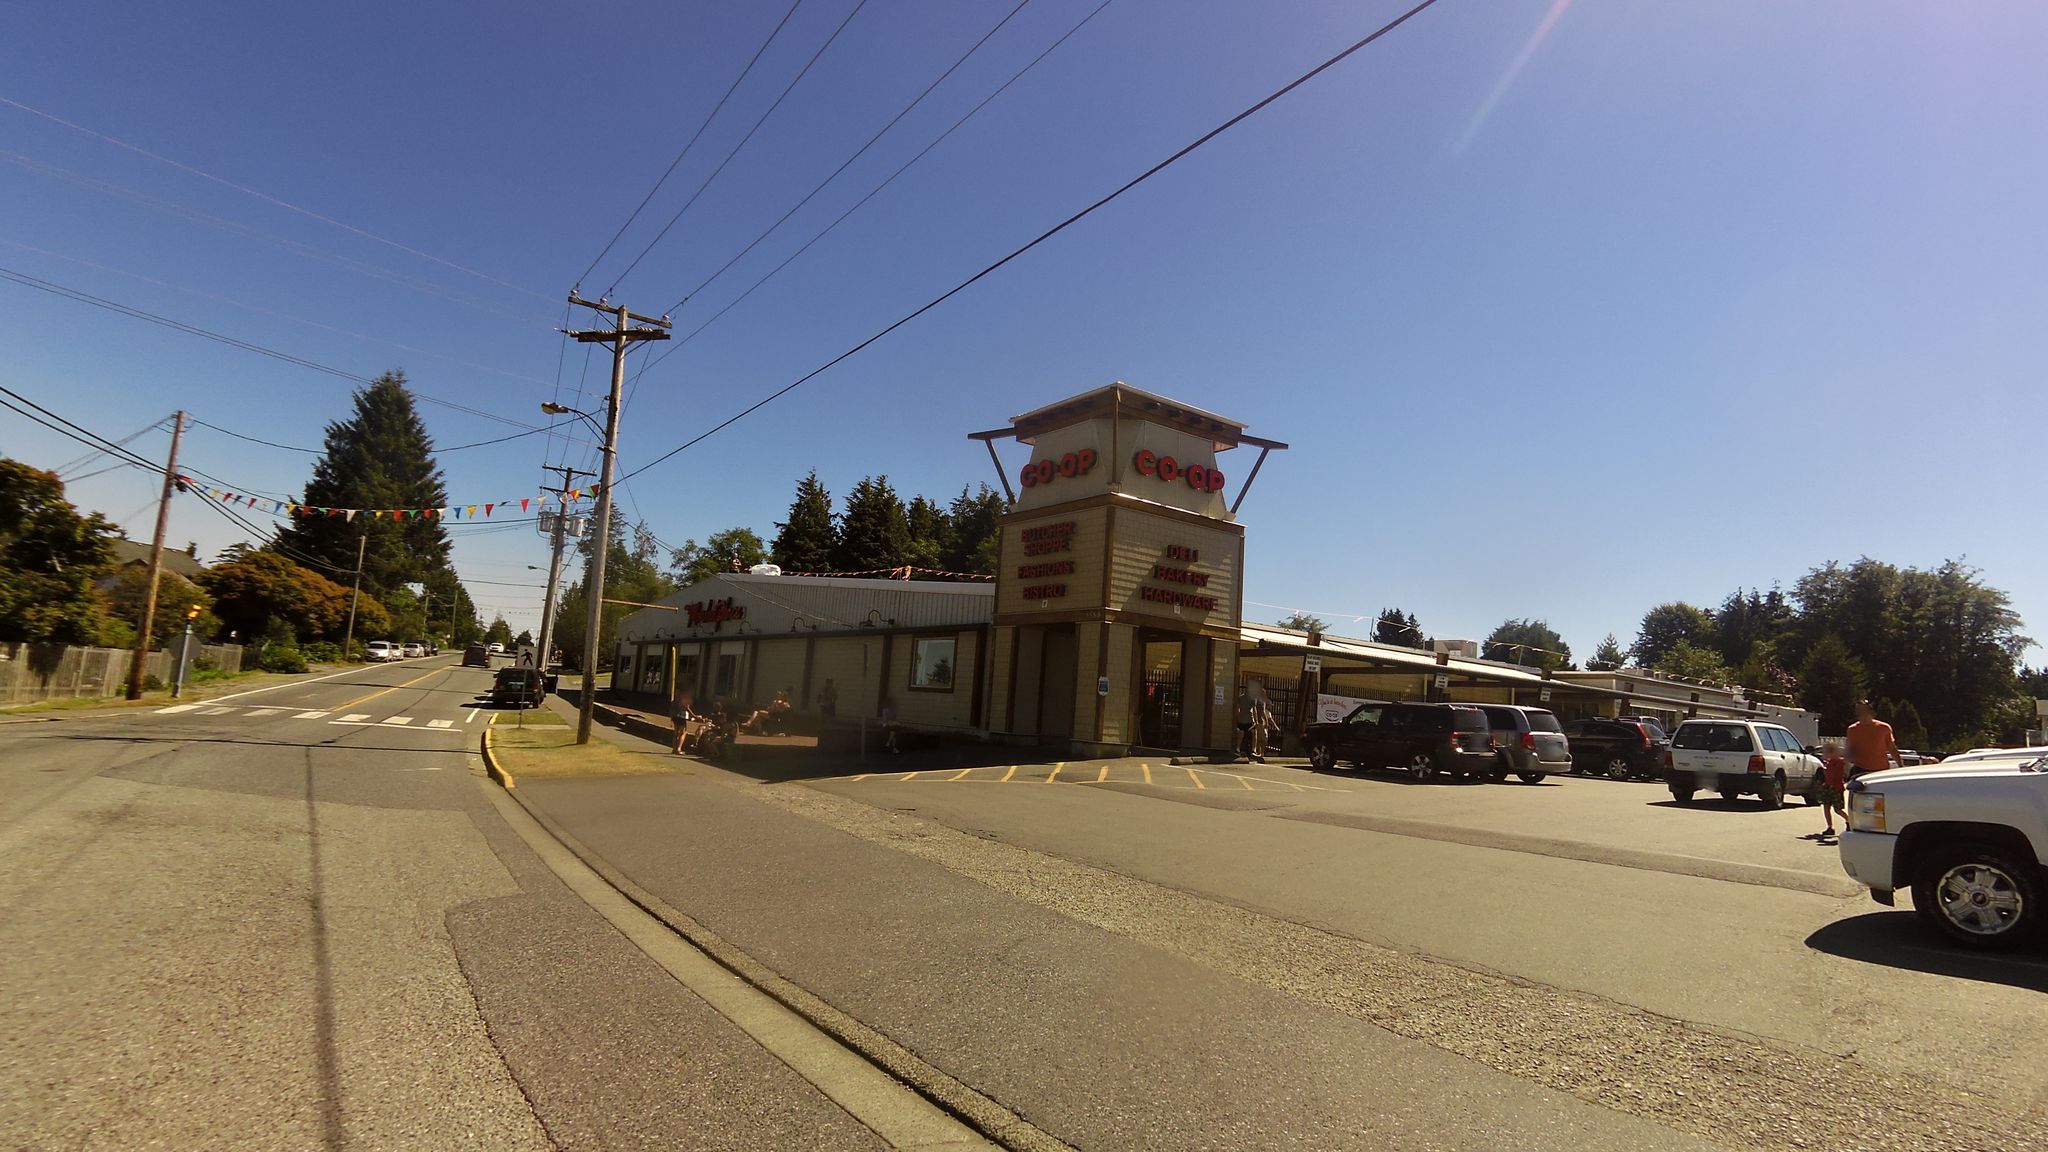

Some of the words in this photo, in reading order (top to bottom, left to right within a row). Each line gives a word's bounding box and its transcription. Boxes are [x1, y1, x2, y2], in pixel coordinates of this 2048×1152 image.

[1020, 447, 1096, 488] CO-OP
[1134, 449, 1225, 494] CO-OP
[1021, 521, 1075, 542] BUTCHER
[1141, 586, 1218, 612] HARDWARE
